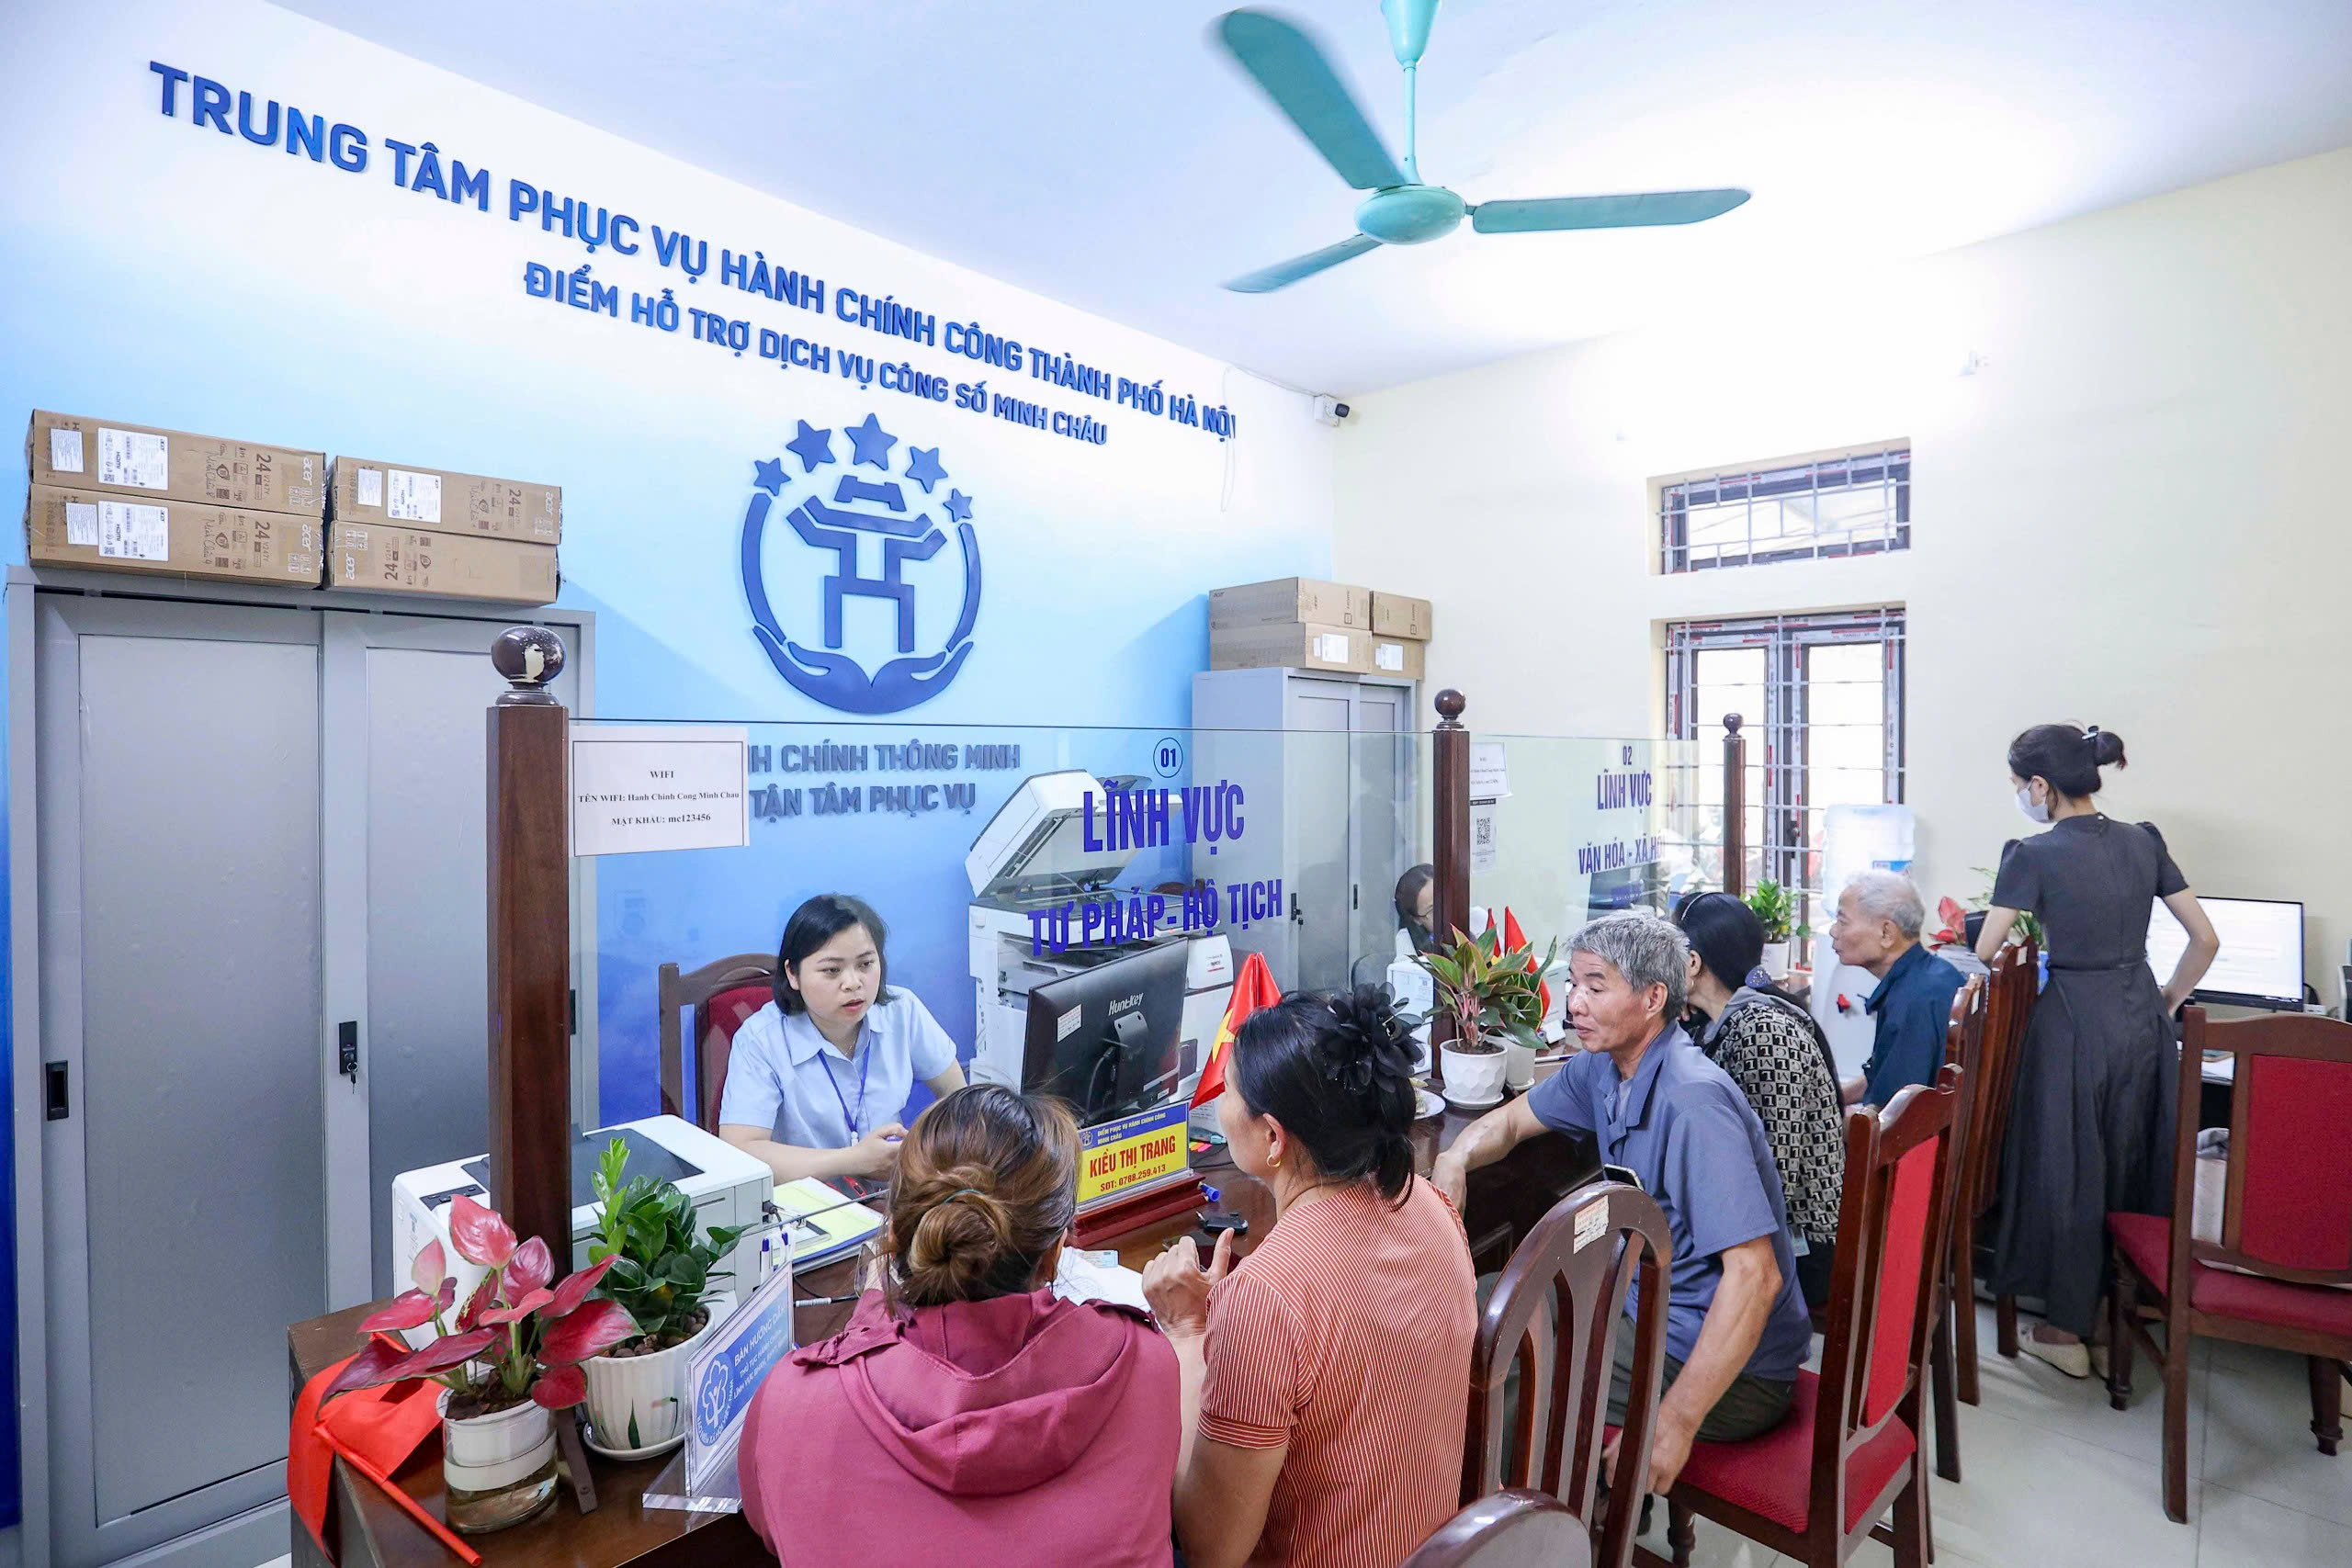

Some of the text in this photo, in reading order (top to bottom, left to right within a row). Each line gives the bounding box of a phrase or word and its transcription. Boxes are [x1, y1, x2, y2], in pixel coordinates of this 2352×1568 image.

[150, 60, 368, 173] TRUNG
[385, 139, 489, 212] TÂM
[509, 178, 639, 254] PHỤC
[651, 225, 707, 284] VỤ
[721, 249, 824, 314] HÀNH
[836, 288, 935, 346] CHÍNH
[944, 321, 1023, 372] CÔNG
[1029, 347, 1112, 400] THÀNH
[1118, 378, 1163, 415] PHỐ
[1170, 394, 1199, 428] HÀ
[524, 261, 1108, 446] ĐIỂM HỖ TRỢ DỊCH VỤ CÔNG SỐ MINH CHÂU
[256, 454, 272, 472] 24
[302, 457, 313, 485] acer
[509, 489, 522, 505] 24
[254, 521, 270, 539] 24
[301, 524, 312, 552] acer
[345, 552, 356, 581] acer
[385, 563, 398, 581] 24
[781, 739, 868, 773] CHÍNH
[874, 739, 958, 771] THÔNG
[965, 744, 1021, 770] MINH
[1160, 748, 1176, 768] 01
[1623, 745, 1632, 765] 02
[650, 770, 674, 779] WIFI
[579, 793, 598, 803] TÊN
[601, 794, 626, 802] WIFI:
[628, 794, 649, 802] Hanh
[651, 793, 675, 801] Chinh
[677, 793, 696, 801] Cong
[720, 791, 740, 799] Chau
[808, 782, 862, 816] TÂM
[869, 784, 939, 818] PHỤC
[944, 783, 976, 815] VỤ
[1598, 768, 1652, 814] LĨNH VỰC
[668, 813, 711, 823] mc123456
[1083, 779, 1244, 855] LĨNH VỰC
[1579, 841, 1600, 874] VĂN
[1604, 837, 1625, 870] HÓA
[1635, 832, 1648, 863] XÃ
[1027, 901, 1073, 956] TƯ
[1082, 886, 1164, 949] PHÁP
[1182, 879, 1218, 936] HỘ
[1227, 879, 1283, 930] TỊCH
[1119, 1146, 1137, 1168] THỊ
[1140, 1135, 1176, 1162] TRANG
[1118, 1164, 1166, 1187] 0788.259.413
